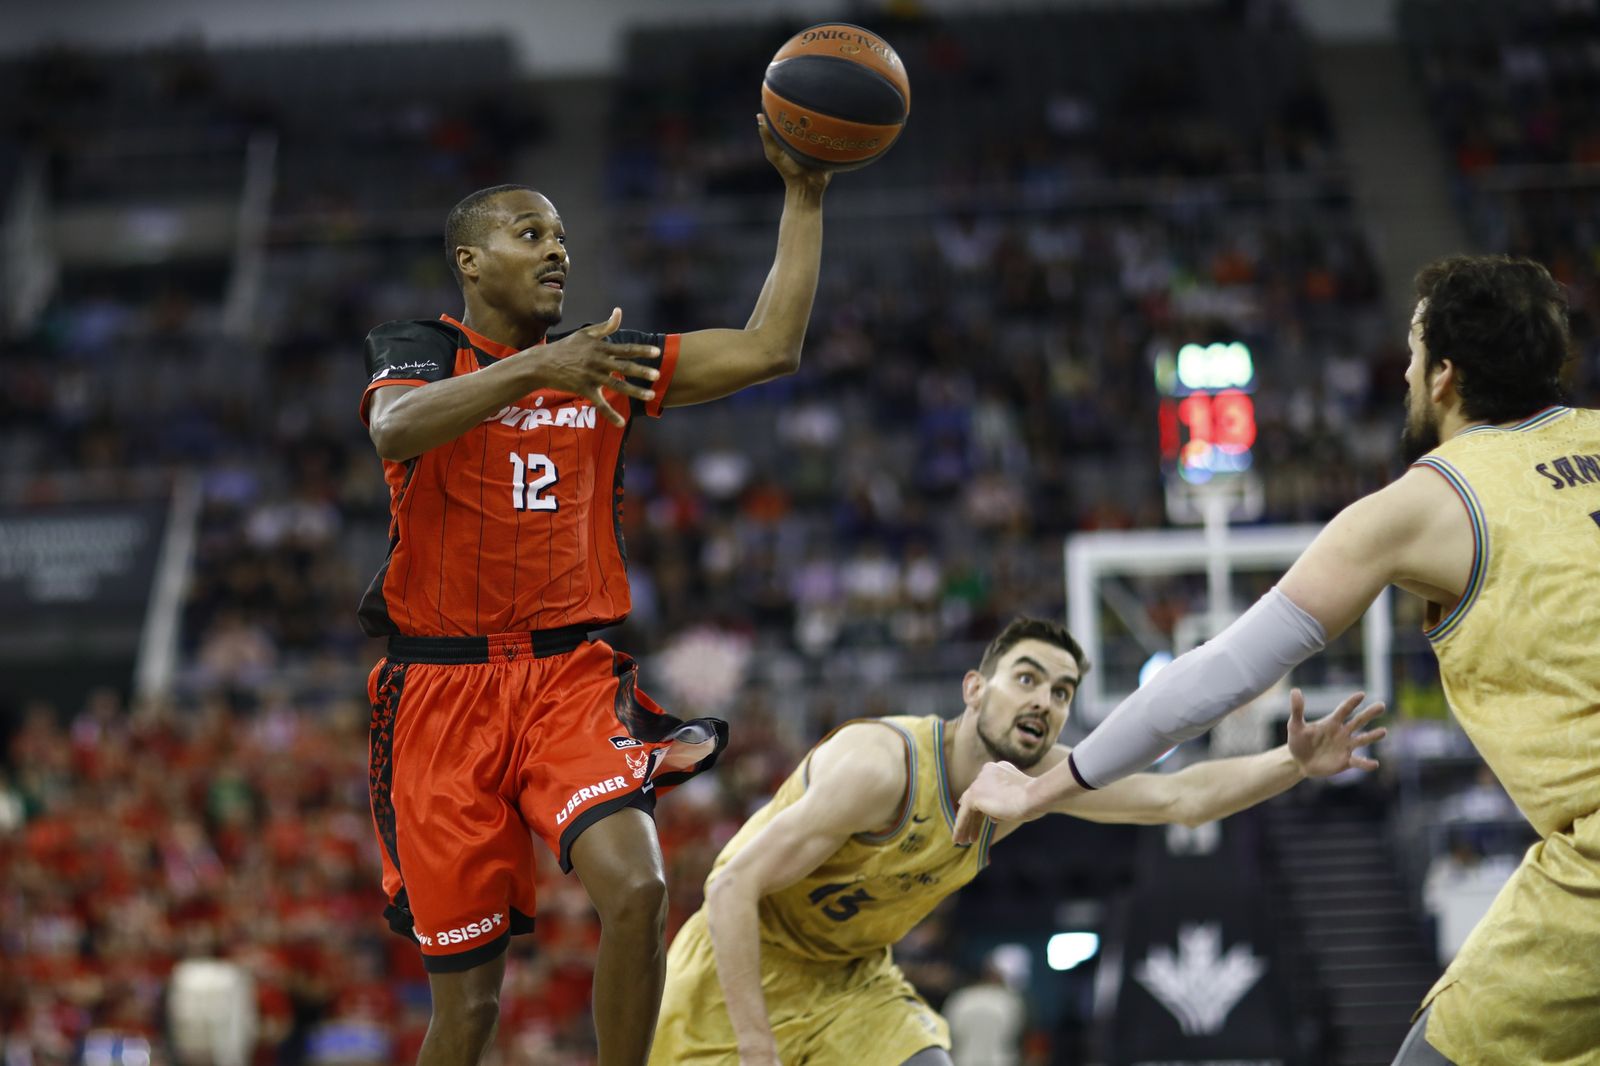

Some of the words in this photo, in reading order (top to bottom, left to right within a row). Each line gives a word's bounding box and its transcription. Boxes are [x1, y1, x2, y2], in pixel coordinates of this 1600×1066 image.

[509, 452, 557, 511] 12
[1535, 454, 1600, 490] SAN
[566, 776, 630, 814] BERNER
[808, 881, 876, 922] 13
